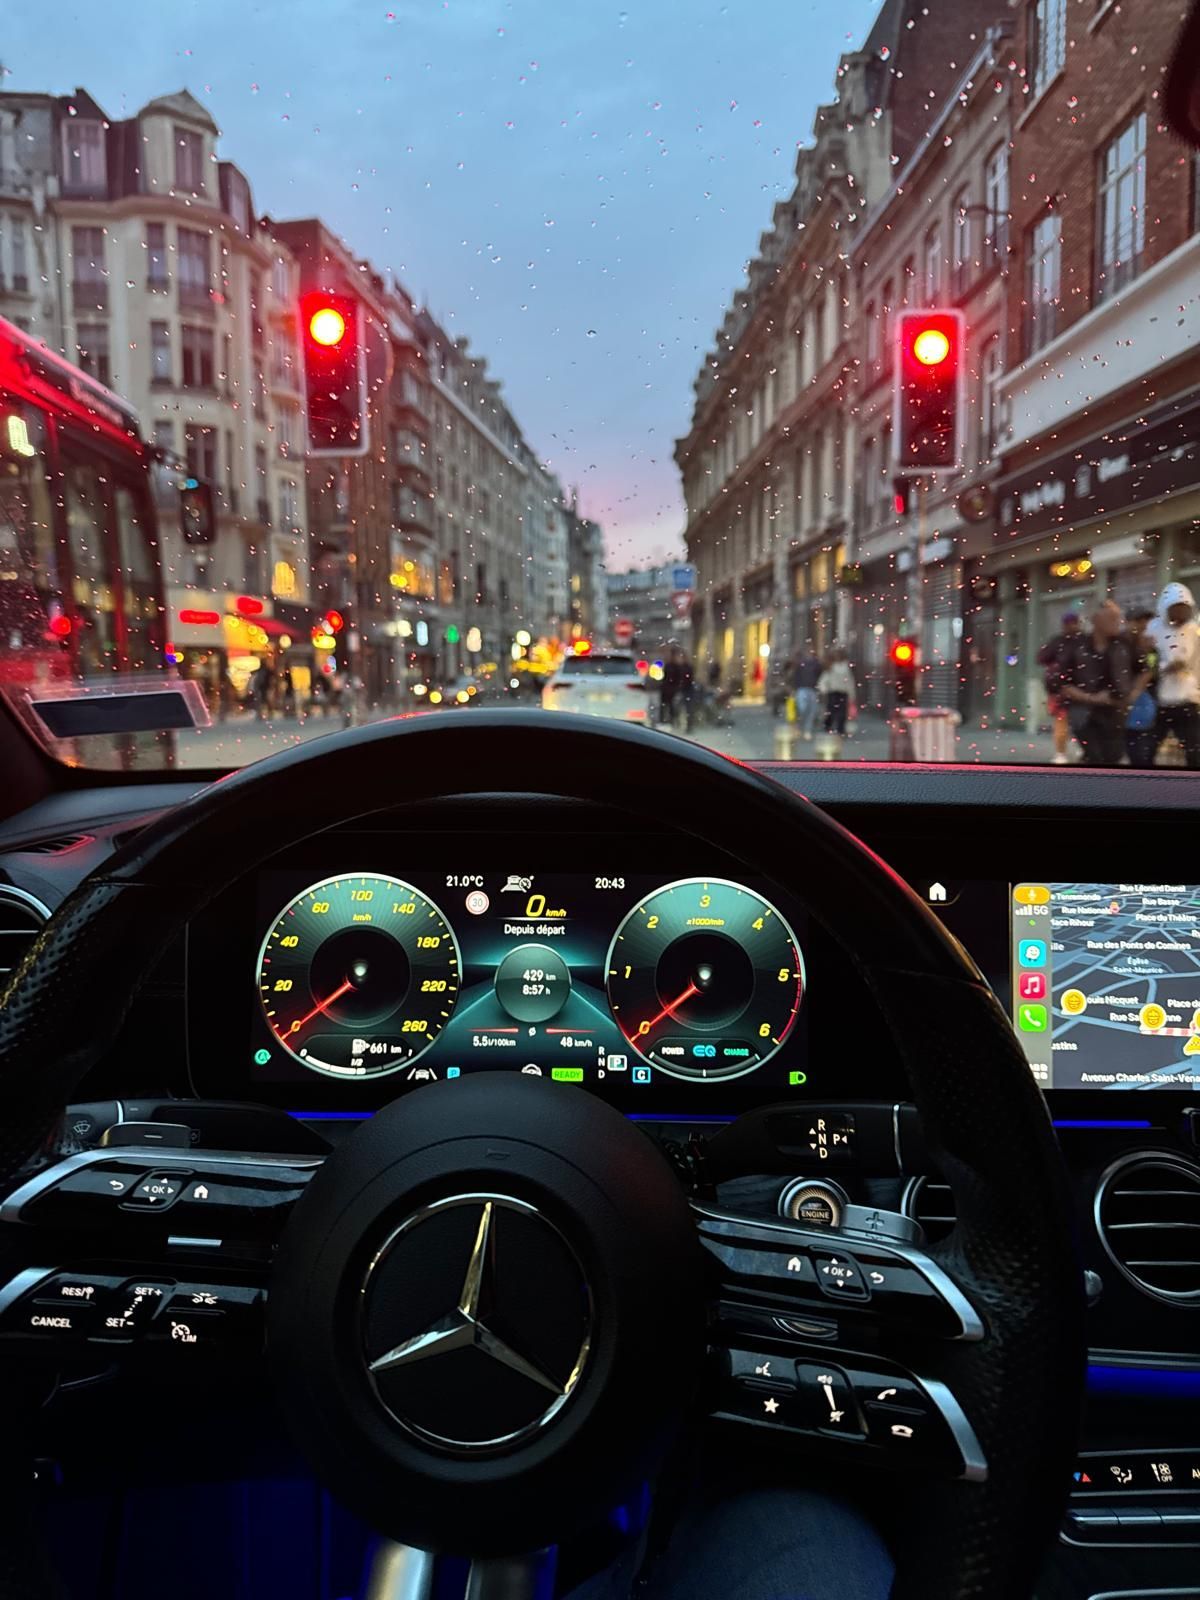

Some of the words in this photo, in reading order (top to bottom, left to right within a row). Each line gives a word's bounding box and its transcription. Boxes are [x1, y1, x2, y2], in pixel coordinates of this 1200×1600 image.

[446, 875, 484, 887] 21.0°C
[595, 877, 625, 889] 20:43
[1120, 884, 1134, 892] Rue
[351, 890, 373, 902] 100
[700, 895, 711, 907] 3
[312, 902, 329, 914] 60
[392, 903, 416, 914] 140
[472, 898, 483, 907] 30
[526, 895, 546, 917] 0
[546, 909, 567, 917] km/h
[1033, 905, 1048, 915] 5G
[352, 913, 372, 921] km/h
[647, 916, 659, 928] 2
[504, 924, 534, 936] Depuis
[536, 924, 565, 936] départ
[752, 918, 763, 930] 4
[280, 936, 299, 948] 40
[416, 936, 440, 948] 180
[1087, 941, 1103, 949] Rue
[1104, 941, 1119, 949] des
[1120, 941, 1144, 949] Ponts
[1144, 941, 1155, 949] de
[522, 970, 543, 981] 429
[625, 965, 632, 979] 1
[778, 968, 789, 982] 5
[274, 980, 292, 992] 20
[421, 980, 446, 992] 220
[522, 985, 544, 995] 8:57
[546, 987, 550, 995] h
[1167, 999, 1191, 1008] Place
[1110, 1013, 1128, 1021] Rue
[291, 1020, 301, 1032] 0
[402, 1020, 427, 1032] 260
[639, 1021, 650, 1034] 0
[759, 1023, 771, 1037] 6
[560, 1037, 573, 1047] 48
[574, 1039, 592, 1047] km/h
[300, 1048, 308, 1057] 0
[370, 1043, 388, 1054] 661
[391, 1045, 402, 1054] km
[598, 1046, 605, 1055] R
[662, 1046, 684, 1055] POWER
[693, 1045, 716, 1057] EQ
[598, 1058, 605, 1066] N
[614, 1058, 621, 1067] P
[598, 1070, 605, 1079] D
[1081, 1073, 1115, 1082] Avenue
[1116, 1073, 1150, 1082] Charles
[817, 1119, 826, 1131] R
[818, 1133, 827, 1145] N
[833, 1134, 841, 1145] P
[819, 1147, 828, 1159] D
[151, 1186, 165, 1194] OK
[801, 1210, 829, 1219] ENGINE
[831, 1267, 844, 1277] OK
[31, 1316, 72, 1328] CANCEL
[181, 1334, 197, 1343] LIM
